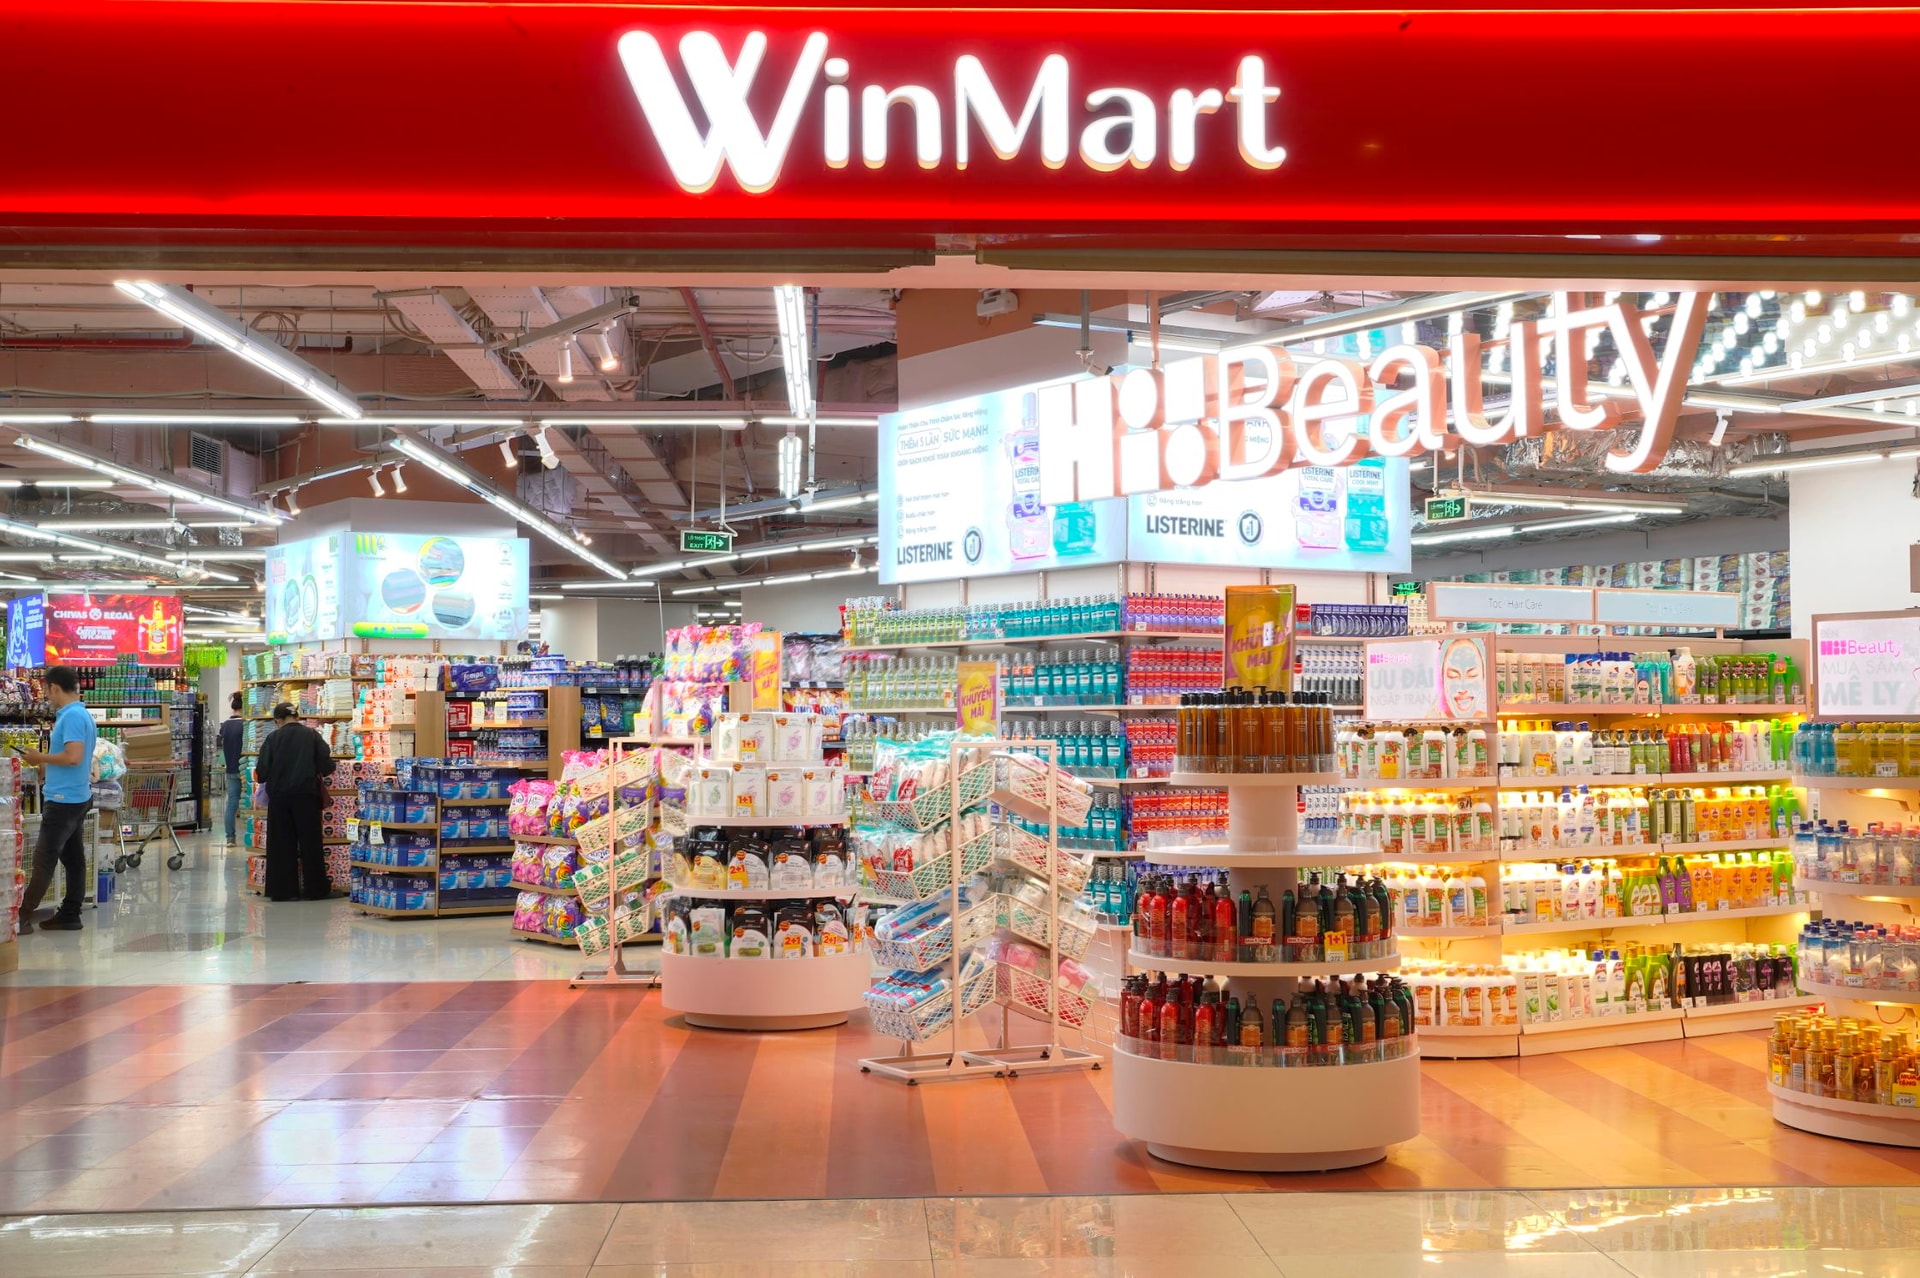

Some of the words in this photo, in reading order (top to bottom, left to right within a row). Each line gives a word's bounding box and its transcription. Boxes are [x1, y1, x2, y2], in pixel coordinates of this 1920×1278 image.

[617, 30, 1287, 193] WinMart
[962, 424, 989, 440] MẠNH
[1015, 465, 1039, 478] LISTERIN
[1301, 467, 1335, 477] LISTERINE
[1349, 469, 1382, 479] LISTERINE
[1146, 514, 1225, 537] LISTERINE
[897, 541, 953, 566] LISTERINE
[53, 610, 88, 619] CHIVAS
[103, 611, 135, 620] REGAL
[1822, 660, 1860, 675] MUA
[461, 671, 484, 682] Tempo
[961, 684, 992, 707] KHUYẾN
[1822, 674, 1863, 706] MÊ
[1873, 681, 1903, 705] LY
[742, 740, 756, 748] 1+1
[1382, 755, 1397, 764] 1+1
[738, 795, 753, 804] 1+1
[730, 865, 745, 874] 2+1
[785, 936, 800, 945] 2+1
[823, 935, 837, 944] 2+1
[1326, 933, 1346, 946] 1+1
